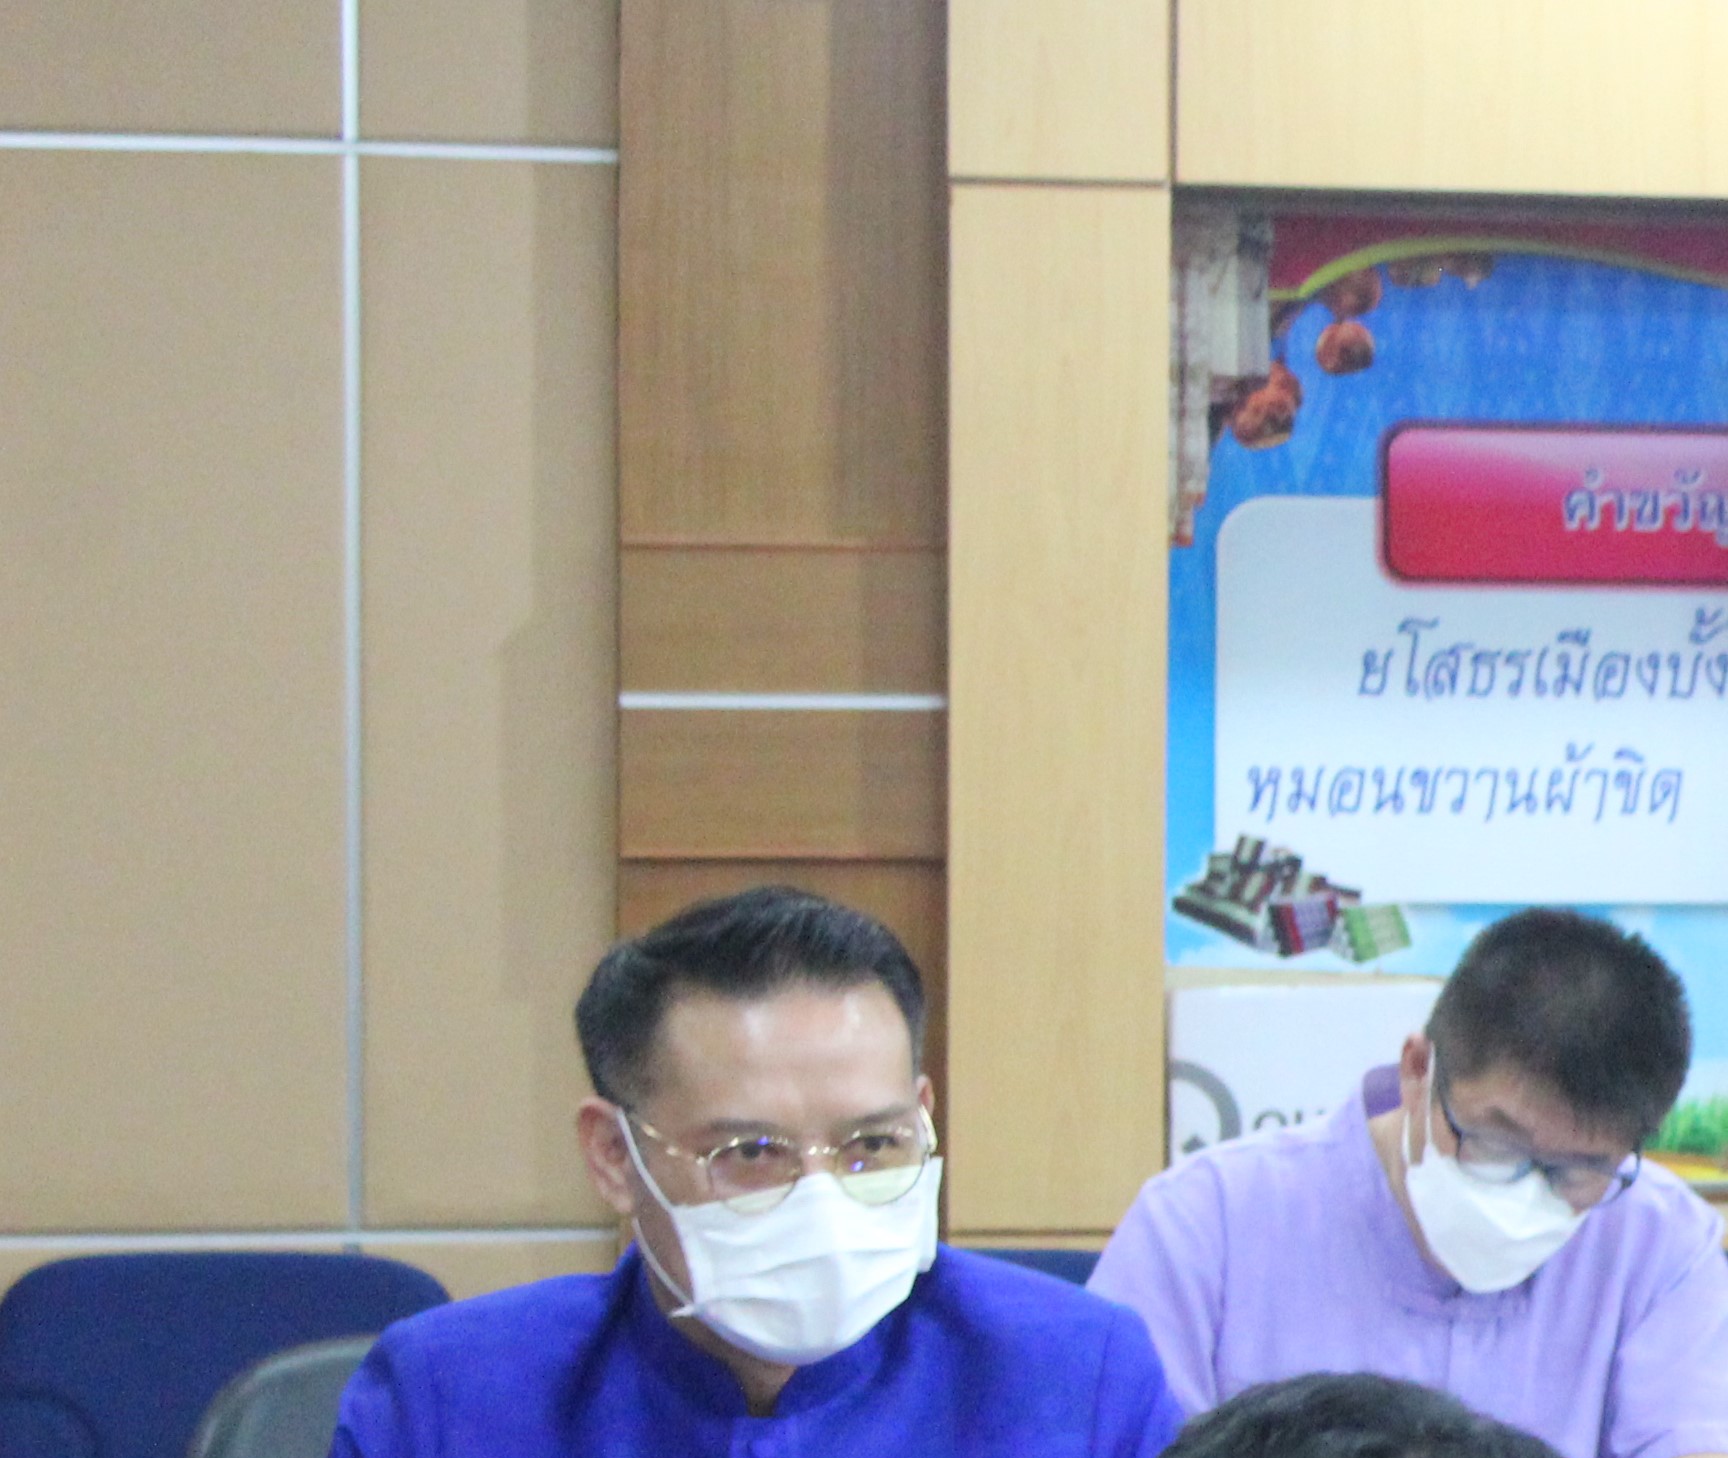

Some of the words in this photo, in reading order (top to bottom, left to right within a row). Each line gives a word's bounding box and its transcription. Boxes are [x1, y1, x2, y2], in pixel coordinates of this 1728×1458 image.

[1246, 742, 1683, 822] หมอนขวานผ้าขิด
